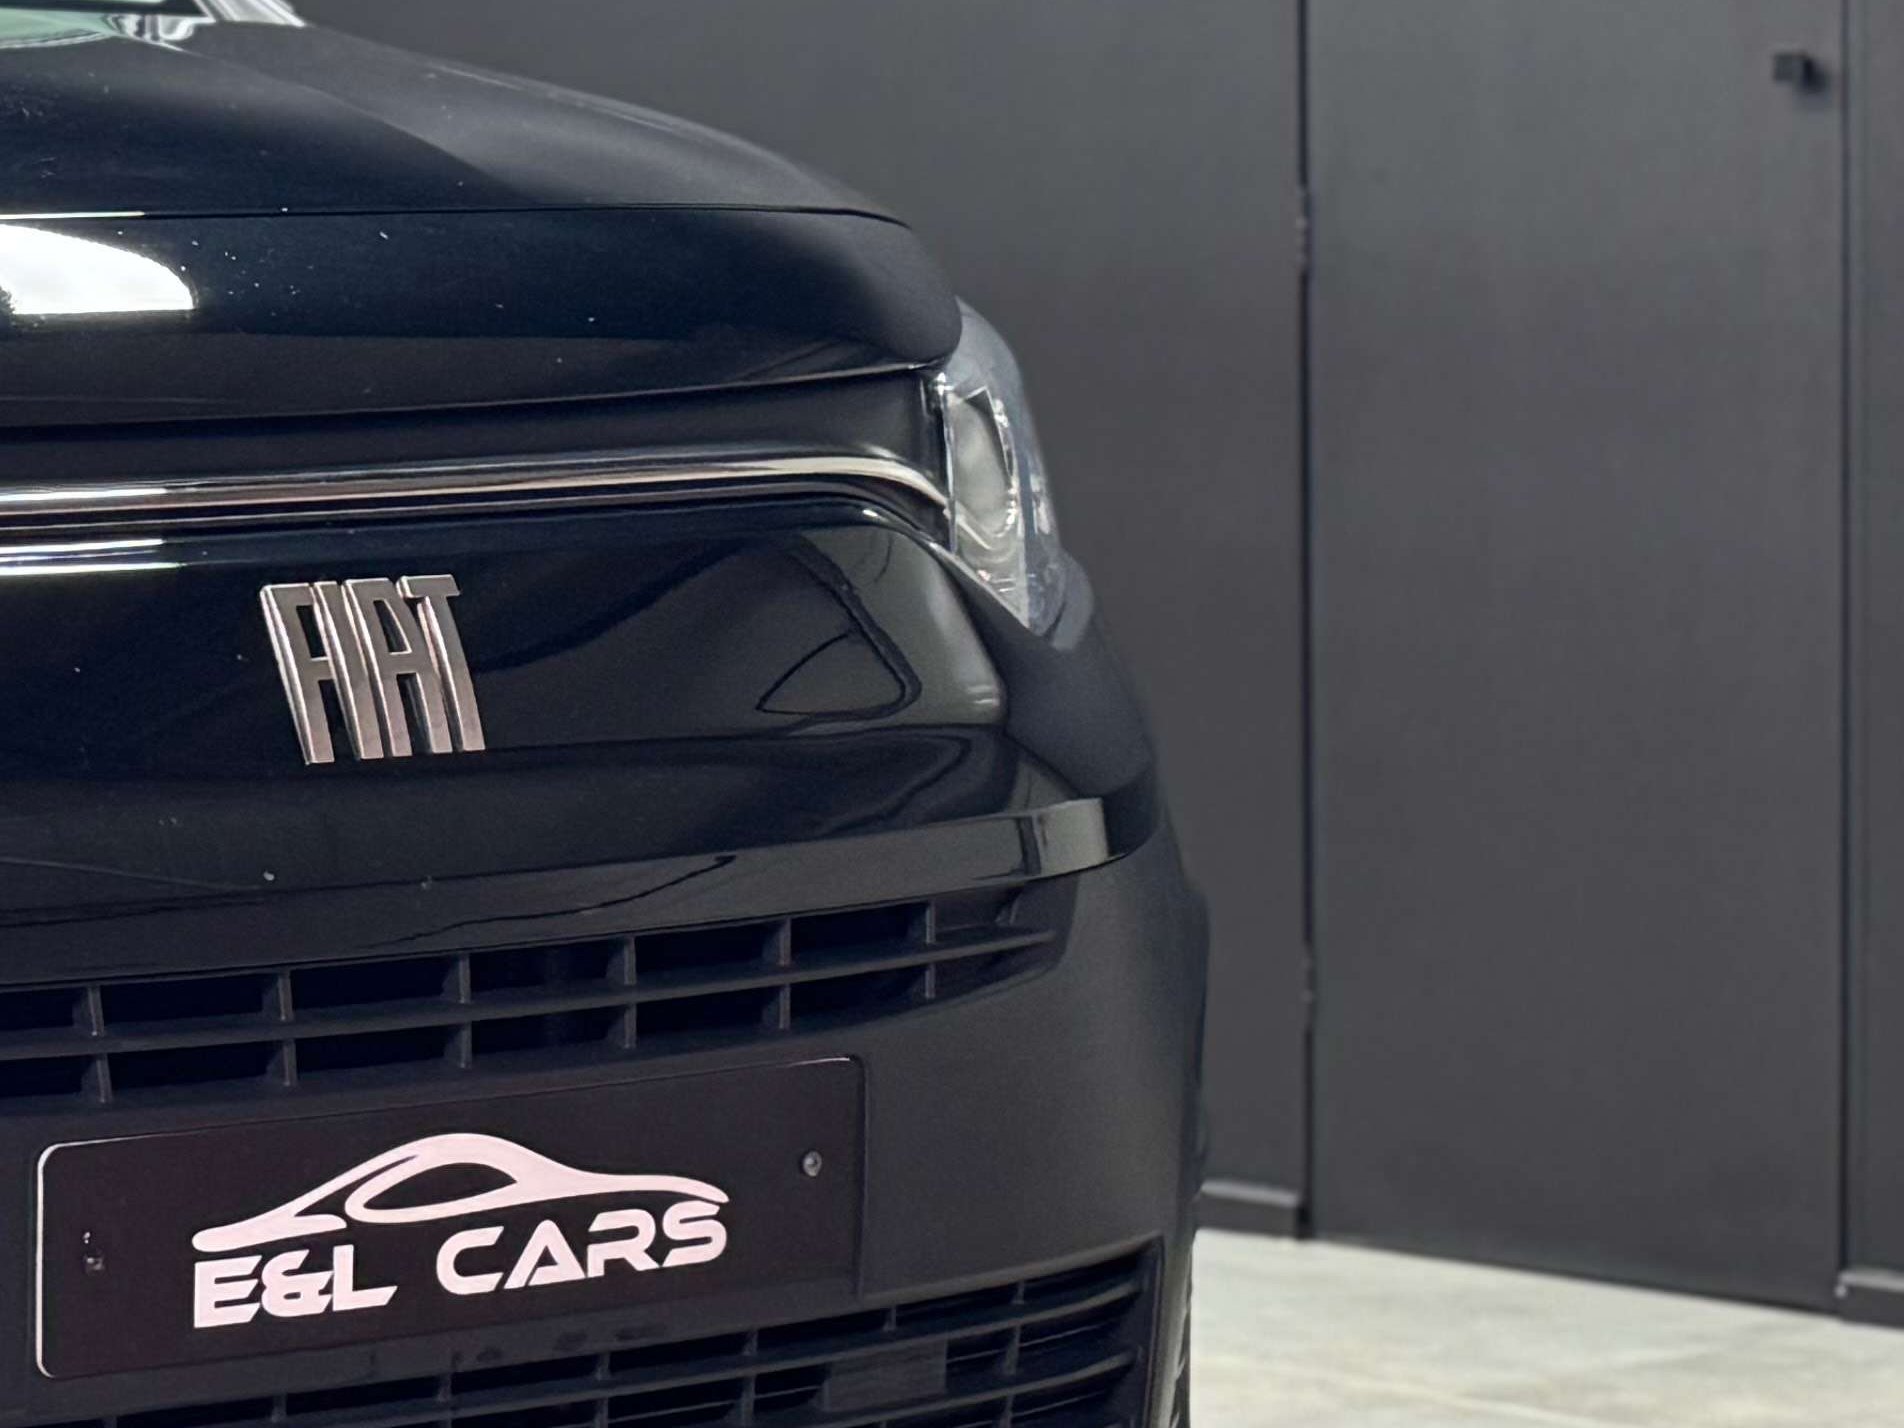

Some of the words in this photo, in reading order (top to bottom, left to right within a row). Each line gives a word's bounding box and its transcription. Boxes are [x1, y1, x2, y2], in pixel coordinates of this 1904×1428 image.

[260, 574, 486, 765] FIAT
[194, 1245, 398, 1329] E&L
[436, 1200, 728, 1296] CARS
